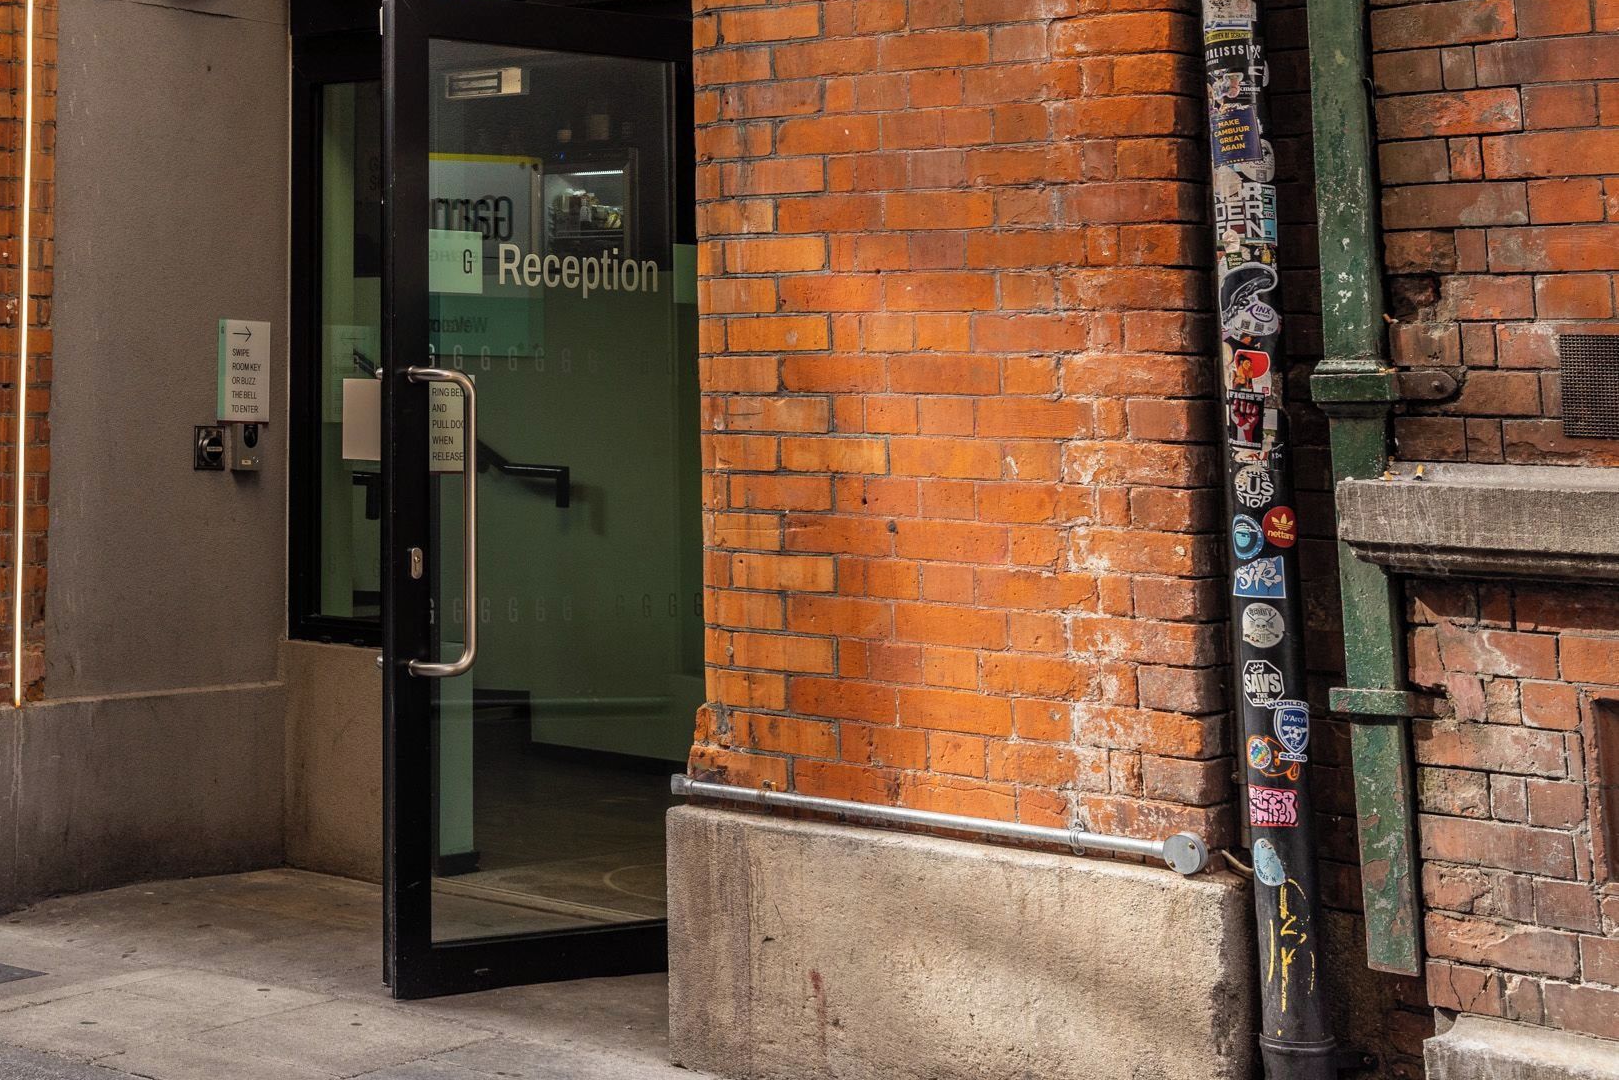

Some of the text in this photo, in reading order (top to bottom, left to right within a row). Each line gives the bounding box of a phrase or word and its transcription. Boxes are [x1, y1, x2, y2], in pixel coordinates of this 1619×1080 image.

[1219, 134, 1244, 144] GREAT
[1221, 143, 1246, 153] AGAIN
[463, 249, 473, 274] G
[498, 243, 658, 299] Reception
[232, 348, 250, 357] SWIPE
[232, 363, 261, 371] ROOM KEY
[232, 377, 256, 385] OR BUZZ
[232, 391, 257, 399] THE BELL
[432, 388, 449, 397] RING
[1229, 390, 1265, 401] FIGHT
[232, 405, 259, 413] TO ENTER
[432, 404, 447, 412] AND
[432, 420, 449, 429] PULL
[432, 436, 453, 445] WHEN
[1236, 491, 1272, 508] STOP
[1244, 673, 1281, 693] SAVS
[1267, 700, 1302, 708] WORLD
[1280, 752, 1307, 761] 2026
